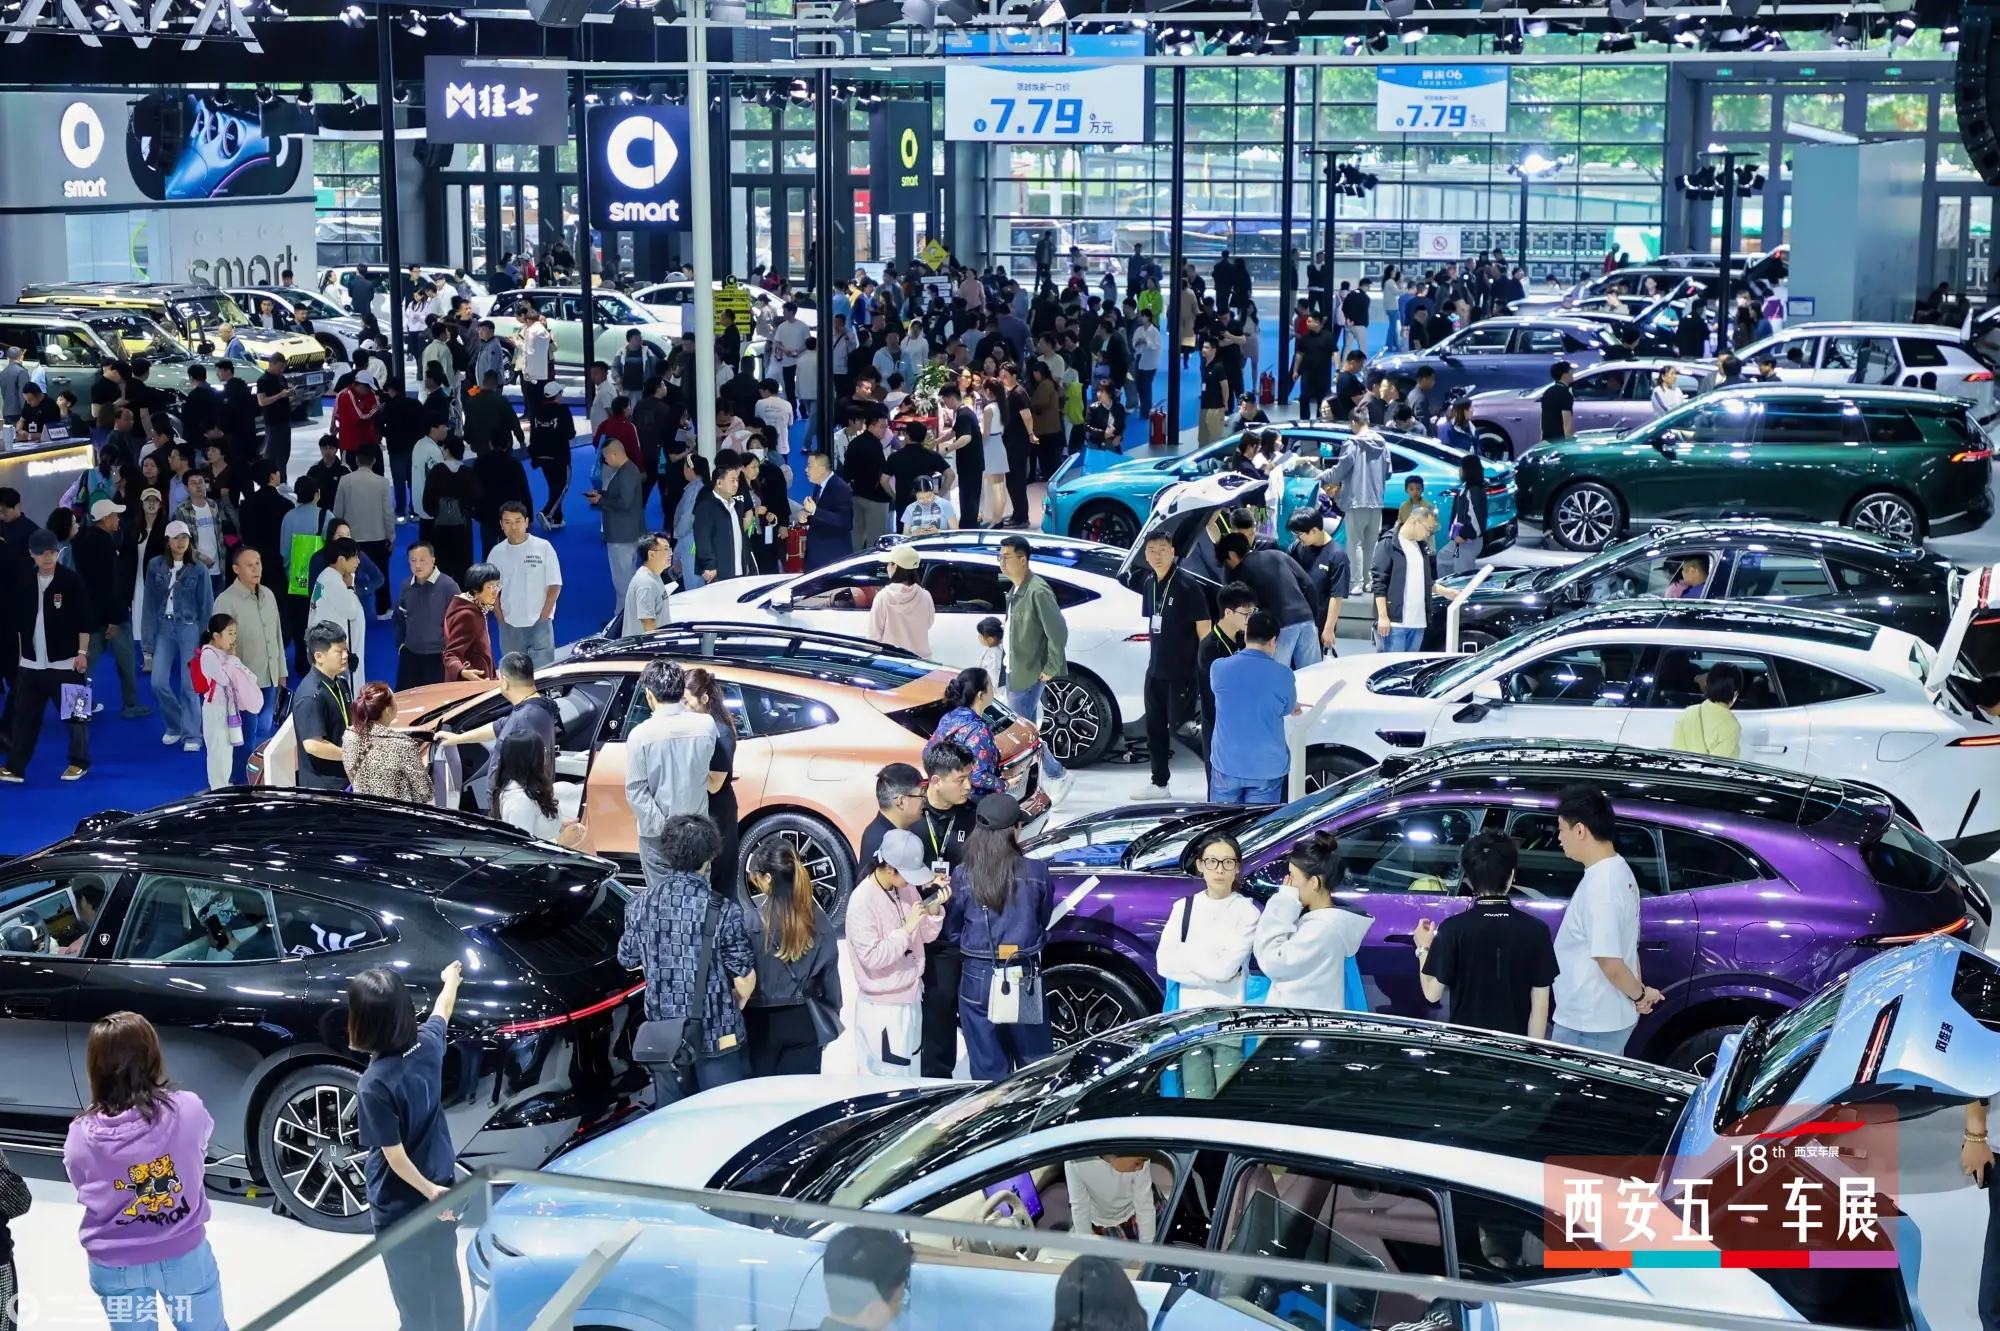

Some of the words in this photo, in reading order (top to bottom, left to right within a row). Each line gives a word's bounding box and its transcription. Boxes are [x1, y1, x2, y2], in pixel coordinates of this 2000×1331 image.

[478, 83, 539, 118] 猛士
[990, 98, 1083, 134] 7.79
[1088, 121, 1114, 134] 万元
[1407, 105, 1468, 127] 7.79
[63, 177, 107, 198] smart
[901, 174, 919, 187] smart
[608, 199, 680, 222] smart
